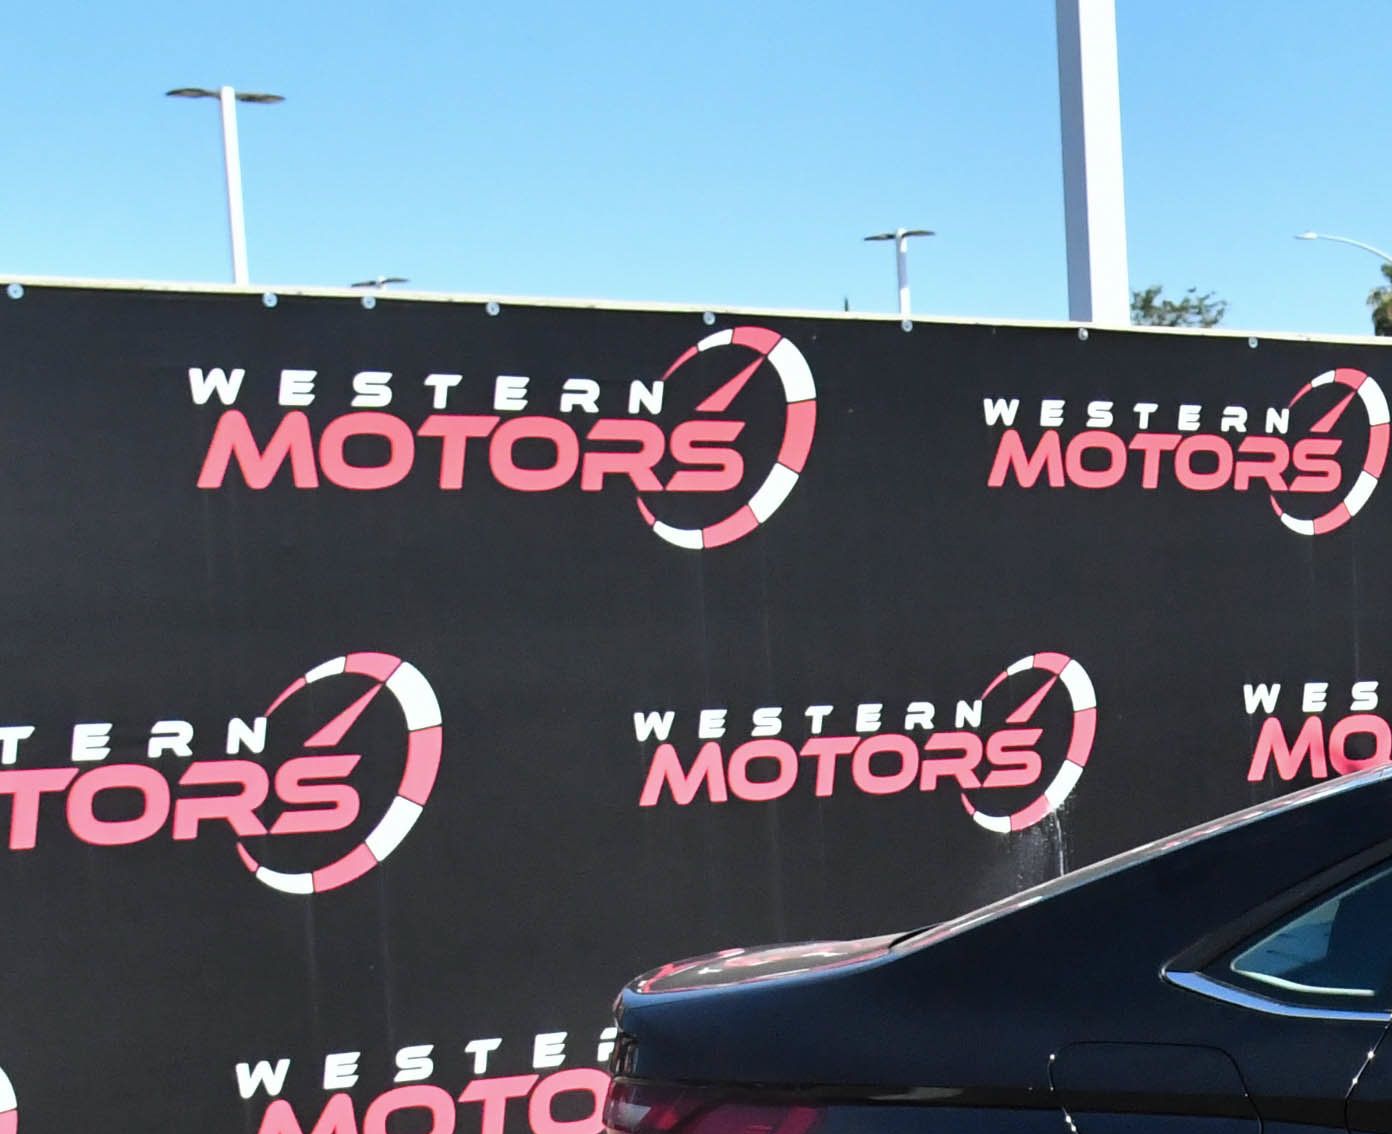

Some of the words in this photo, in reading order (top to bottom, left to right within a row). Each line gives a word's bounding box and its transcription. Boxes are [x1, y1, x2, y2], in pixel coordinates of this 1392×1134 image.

[188, 367, 664, 415] WESTERN
[983, 398, 1290, 434] WESTERN
[197, 409, 746, 492] MOTORS
[987, 429, 1342, 492] MOTORS
[0, 716, 268, 765] TERN
[634, 699, 983, 742] WESTERN
[639, 728, 1043, 807] MOTORS
[0, 754, 361, 851] TORS
